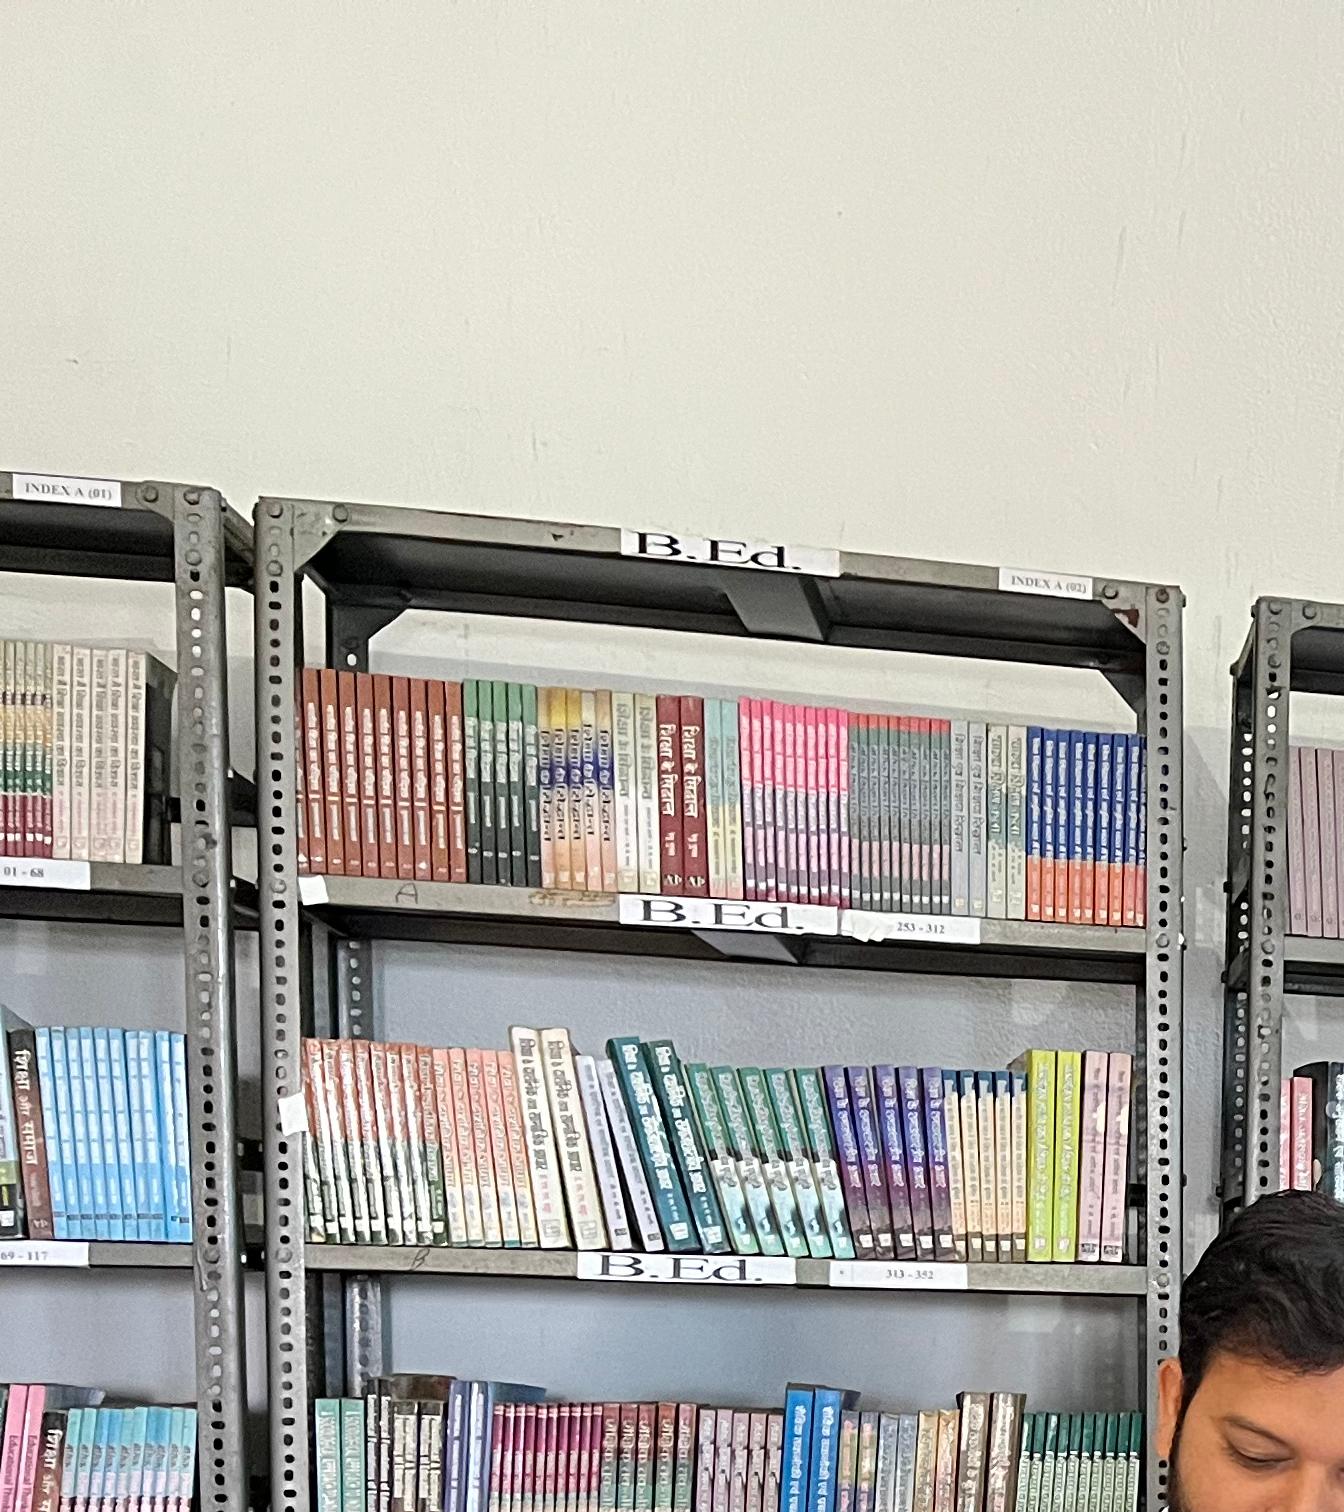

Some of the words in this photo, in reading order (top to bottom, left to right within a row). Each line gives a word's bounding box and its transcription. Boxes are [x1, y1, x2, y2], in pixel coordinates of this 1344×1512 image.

[25, 482, 70, 496] INDEX
[75, 484, 84, 497] A
[88, 486, 112, 501] (01)
[636, 532, 802, 570] B.Ed.
[1011, 574, 1050, 589] INDEX
[1054, 578, 1063, 591] A
[1065, 580, 1087, 595] (02)
[30, 868, 45, 880] 68
[396, 882, 419, 905] A
[640, 900, 805, 931] B.Ed.
[897, 922, 914, 934] 253
[926, 924, 945, 936] 312
[26, 1250, 49, 1262] 117
[600, 1255, 761, 1283] B.Ed.
[885, 1269, 904, 1279] 313
[5, 1435, 19, 1485] Educational
[22, 1435, 37, 1485] Educational
